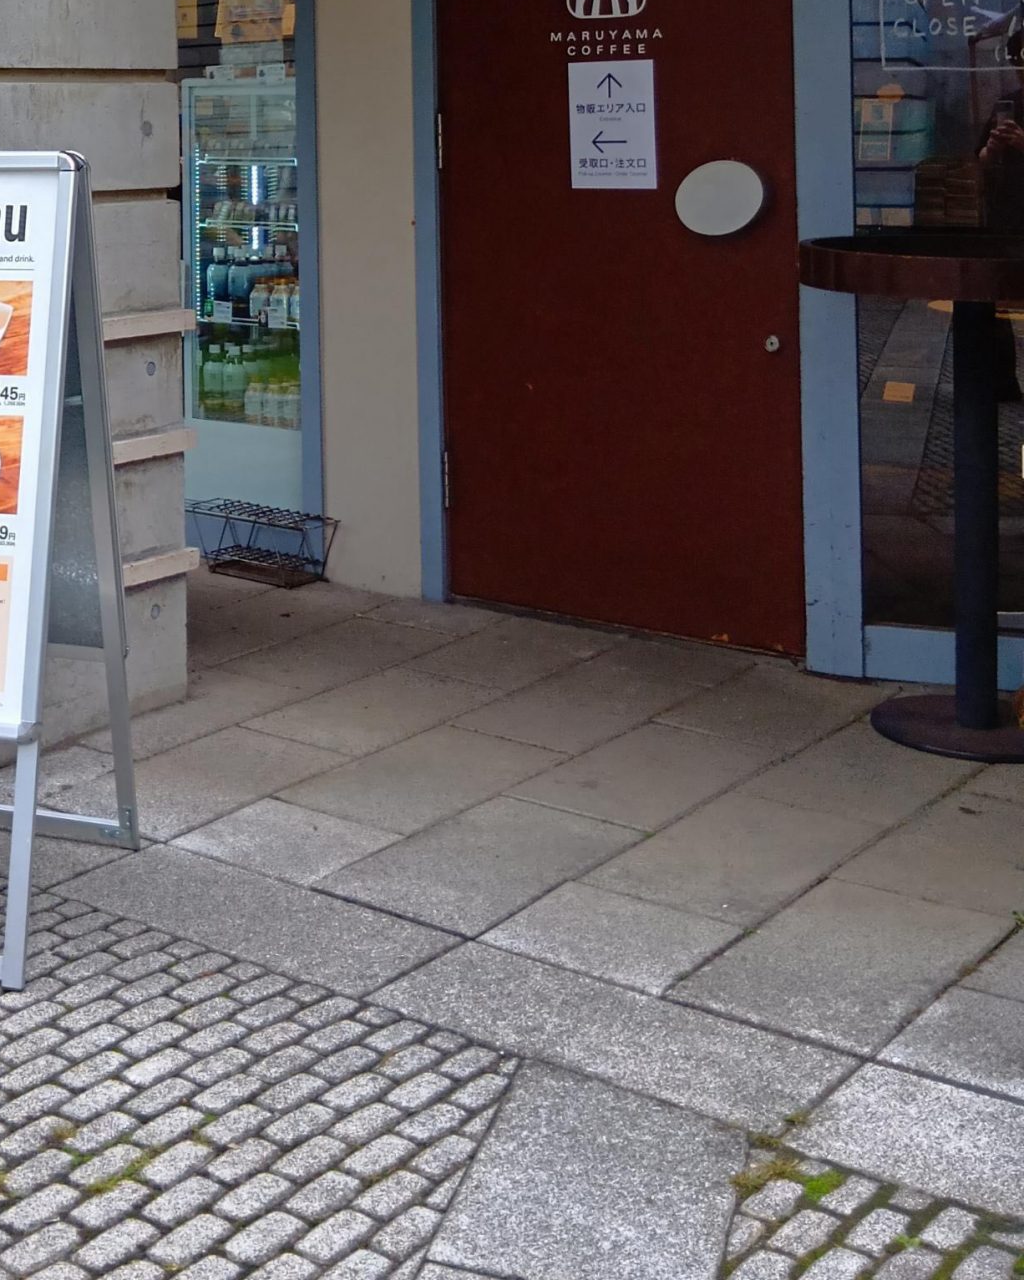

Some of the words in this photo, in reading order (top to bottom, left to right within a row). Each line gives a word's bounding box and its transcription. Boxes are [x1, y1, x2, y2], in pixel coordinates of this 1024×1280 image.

[893, 16, 978, 37] CLOSE
[550, 28, 663, 42] MARUYAMA
[567, 43, 647, 56] COFFEE
[576, 103, 646, 114] 物販エリア入口
[579, 158, 647, 169] 受取口・注文口
